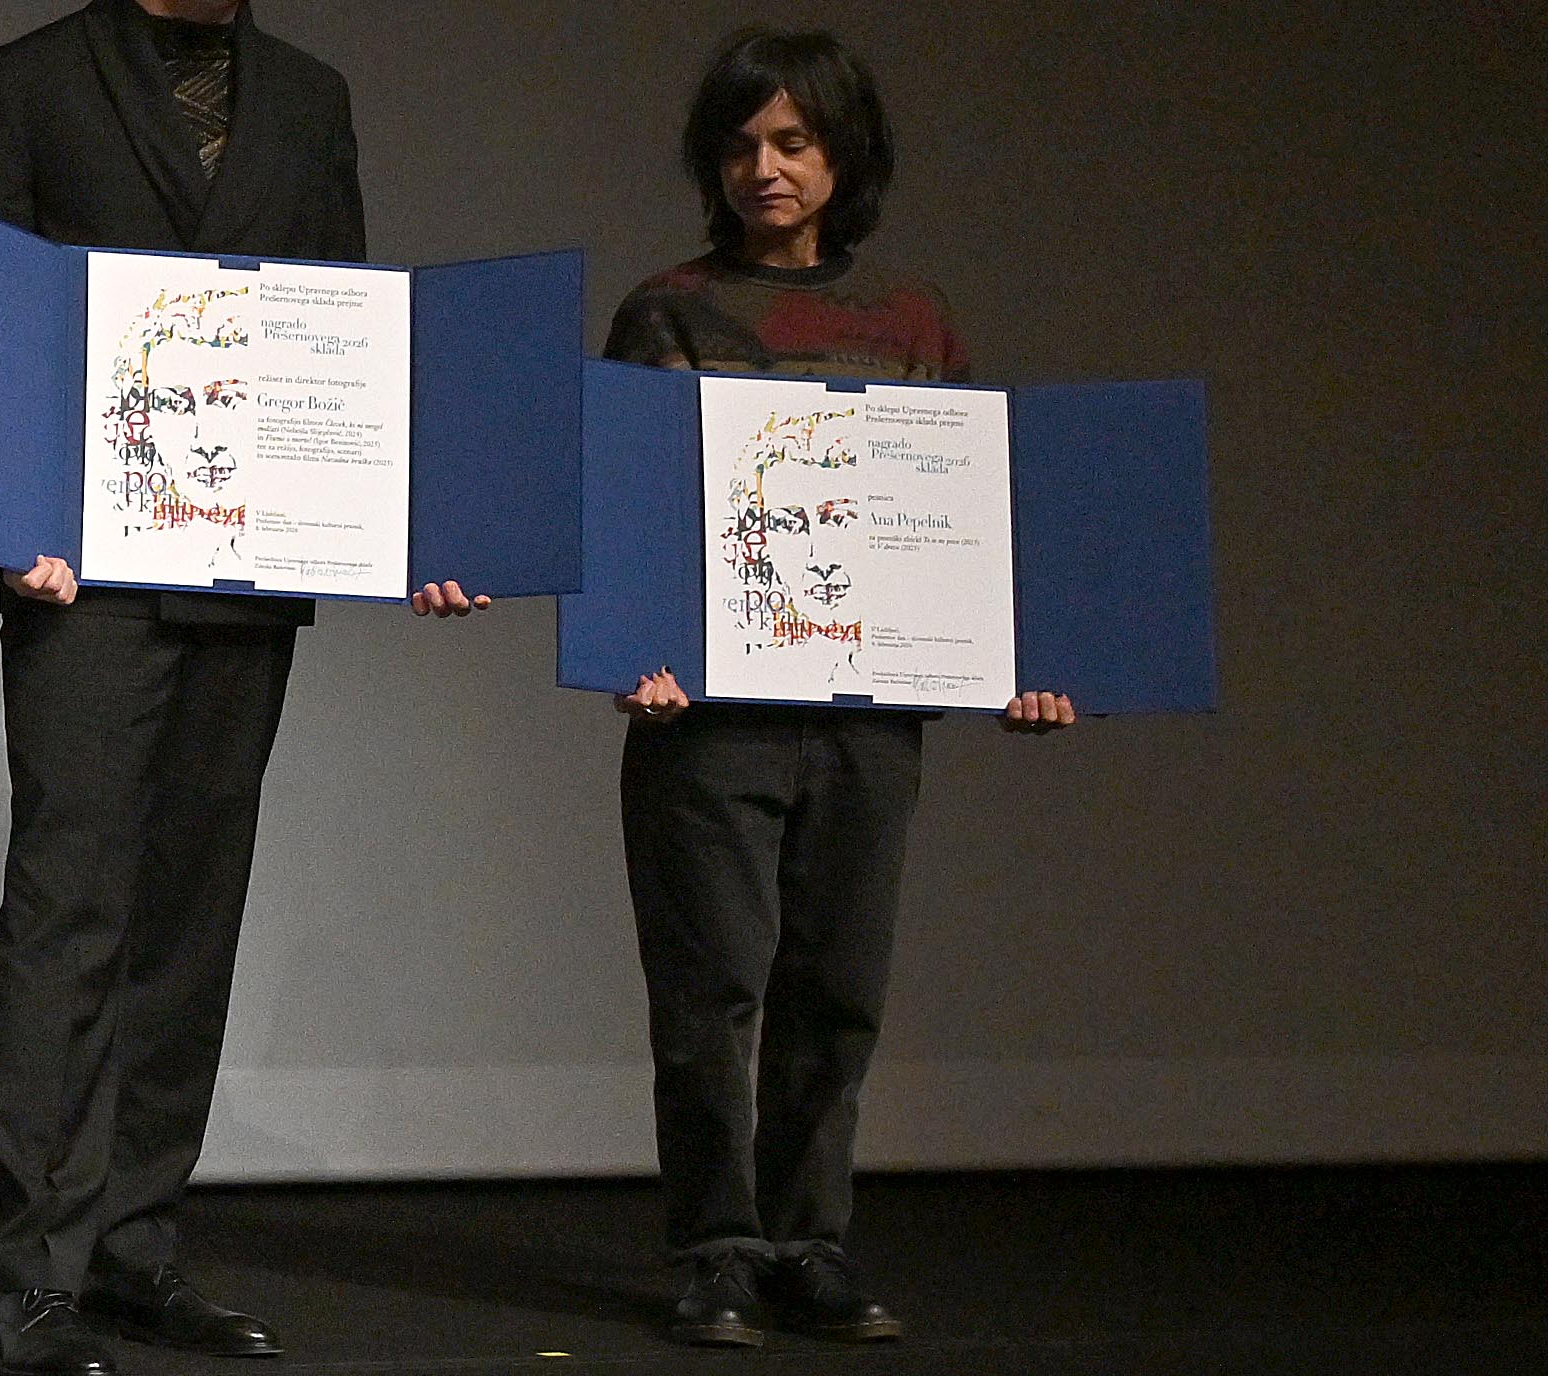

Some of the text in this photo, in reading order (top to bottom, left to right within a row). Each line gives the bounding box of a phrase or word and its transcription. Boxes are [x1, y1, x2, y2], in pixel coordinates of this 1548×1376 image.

[260, 283, 368, 297] Po sklepu Upravnega odbora
[260, 294, 363, 308] Prešernovega sklada prejme
[261, 318, 306, 330] nagrado
[265, 328, 368, 347] Prešernovega 2026
[310, 343, 345, 355] sklada
[295, 376, 326, 385] direktor
[328, 378, 366, 389] fotografije
[257, 393, 305, 414] Gregor
[871, 512, 952, 532] Ana Pepelnik
